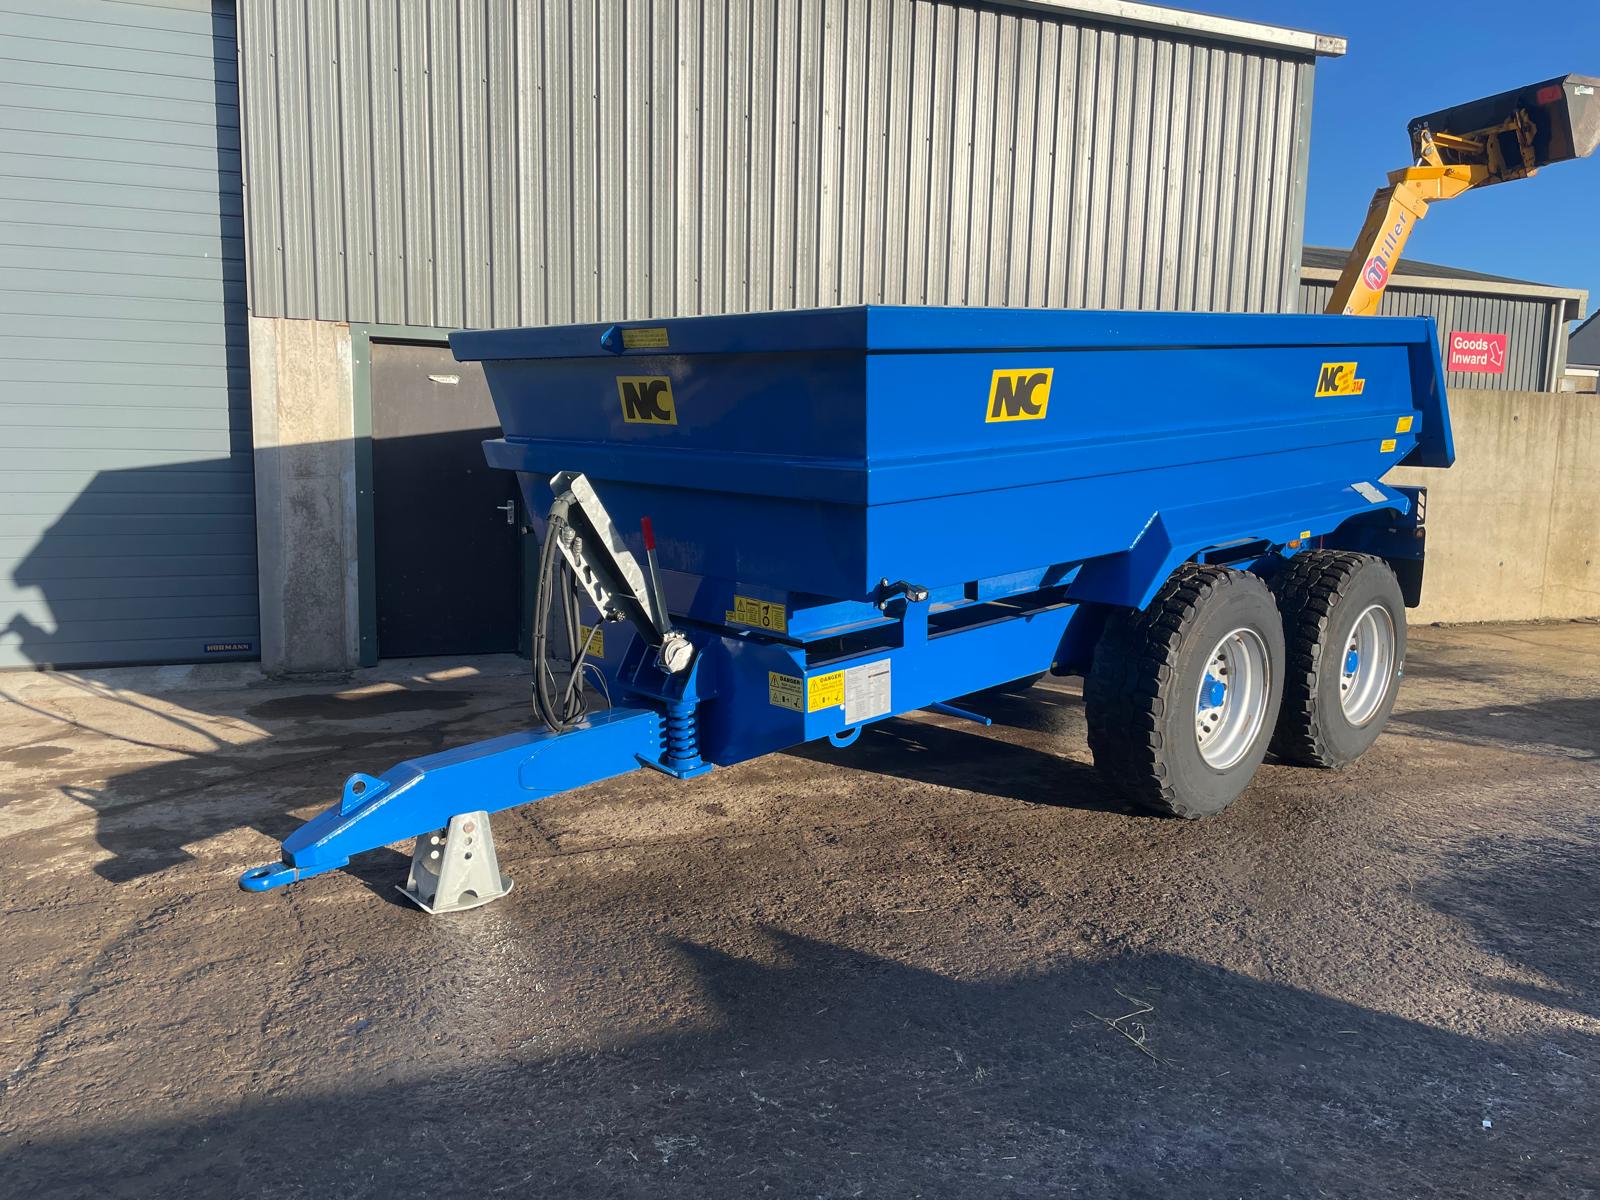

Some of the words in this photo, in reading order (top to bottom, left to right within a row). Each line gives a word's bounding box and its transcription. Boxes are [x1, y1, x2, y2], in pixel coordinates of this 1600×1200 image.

[1454, 337, 1488, 350] Goods
[1452, 351, 1488, 365] Inward
[1318, 365, 1344, 392] NC
[622, 380, 671, 420] NC
[991, 372, 1048, 417] NC
